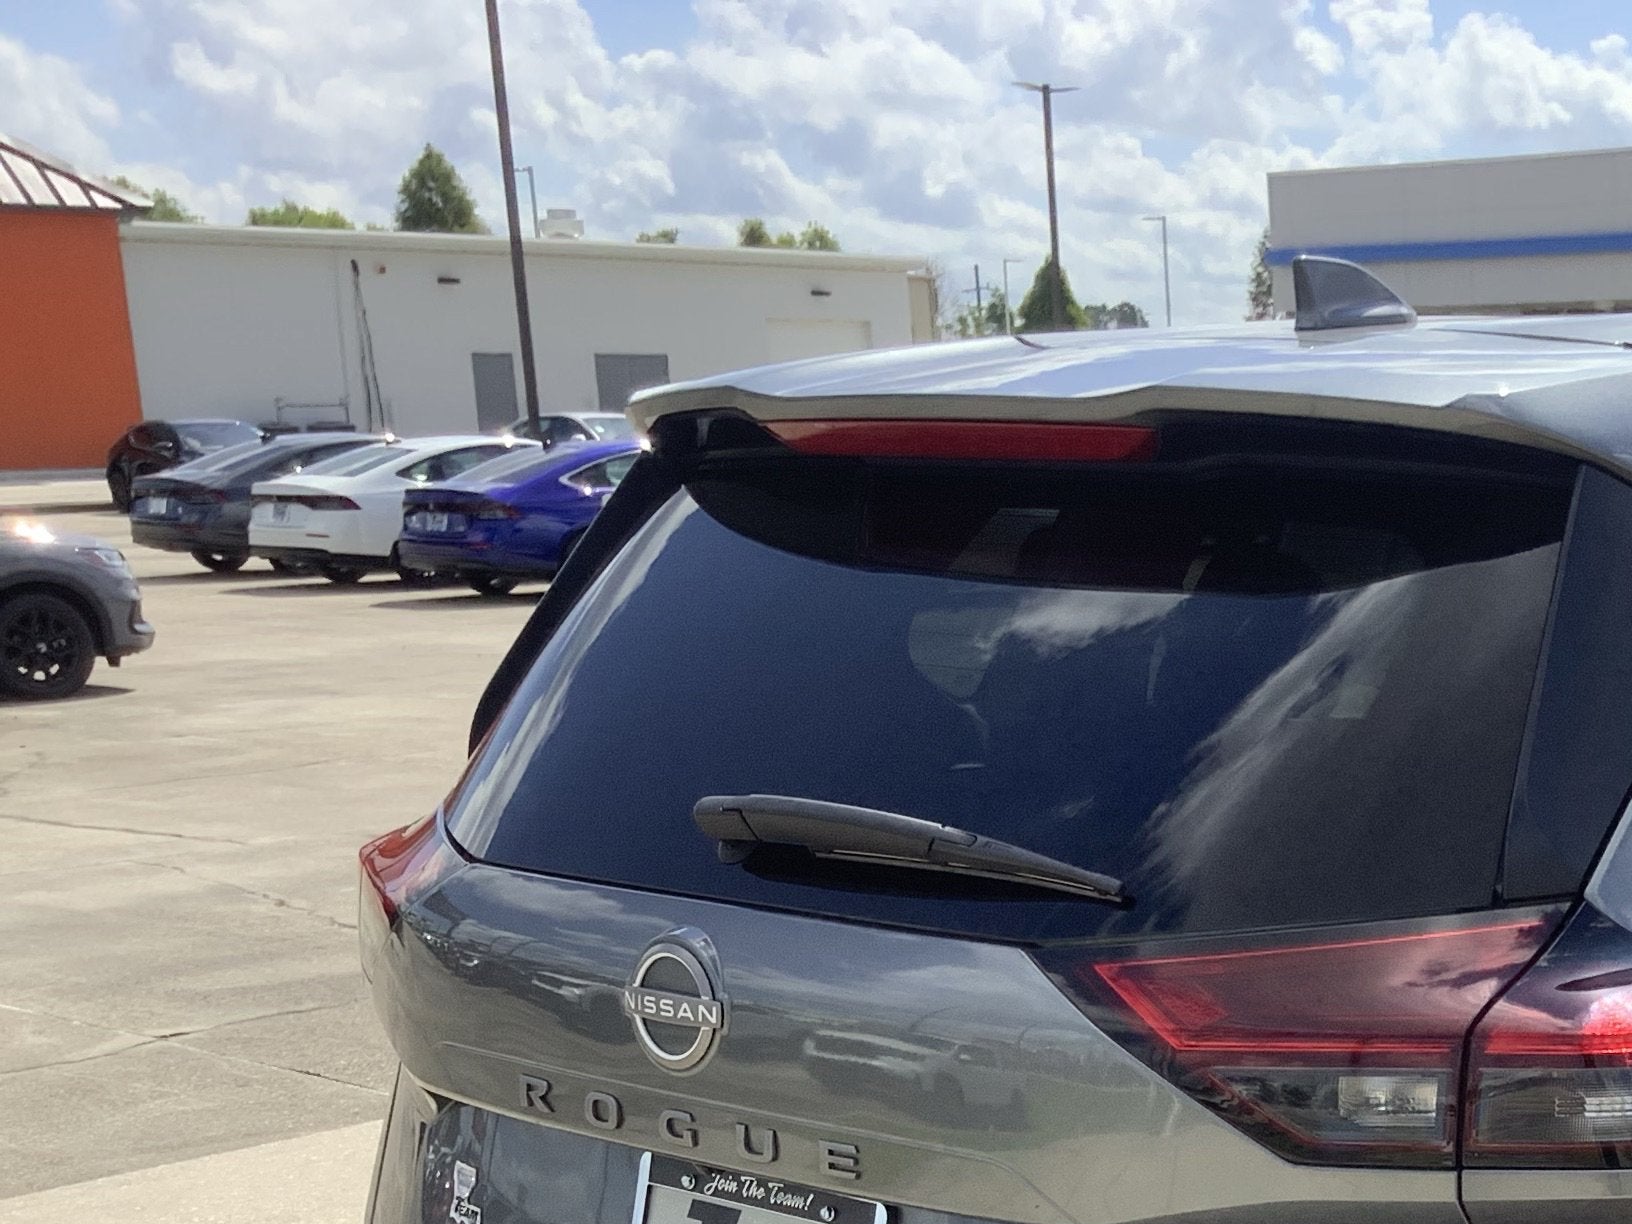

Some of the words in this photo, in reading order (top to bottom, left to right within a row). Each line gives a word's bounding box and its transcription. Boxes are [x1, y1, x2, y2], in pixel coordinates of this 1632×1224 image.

[625, 990, 718, 1026] NISSAN
[519, 1072, 861, 1180] ROGUE
[703, 1173, 738, 1196] Join
[740, 1176, 766, 1200] The
[768, 1182, 814, 1211] Team!
